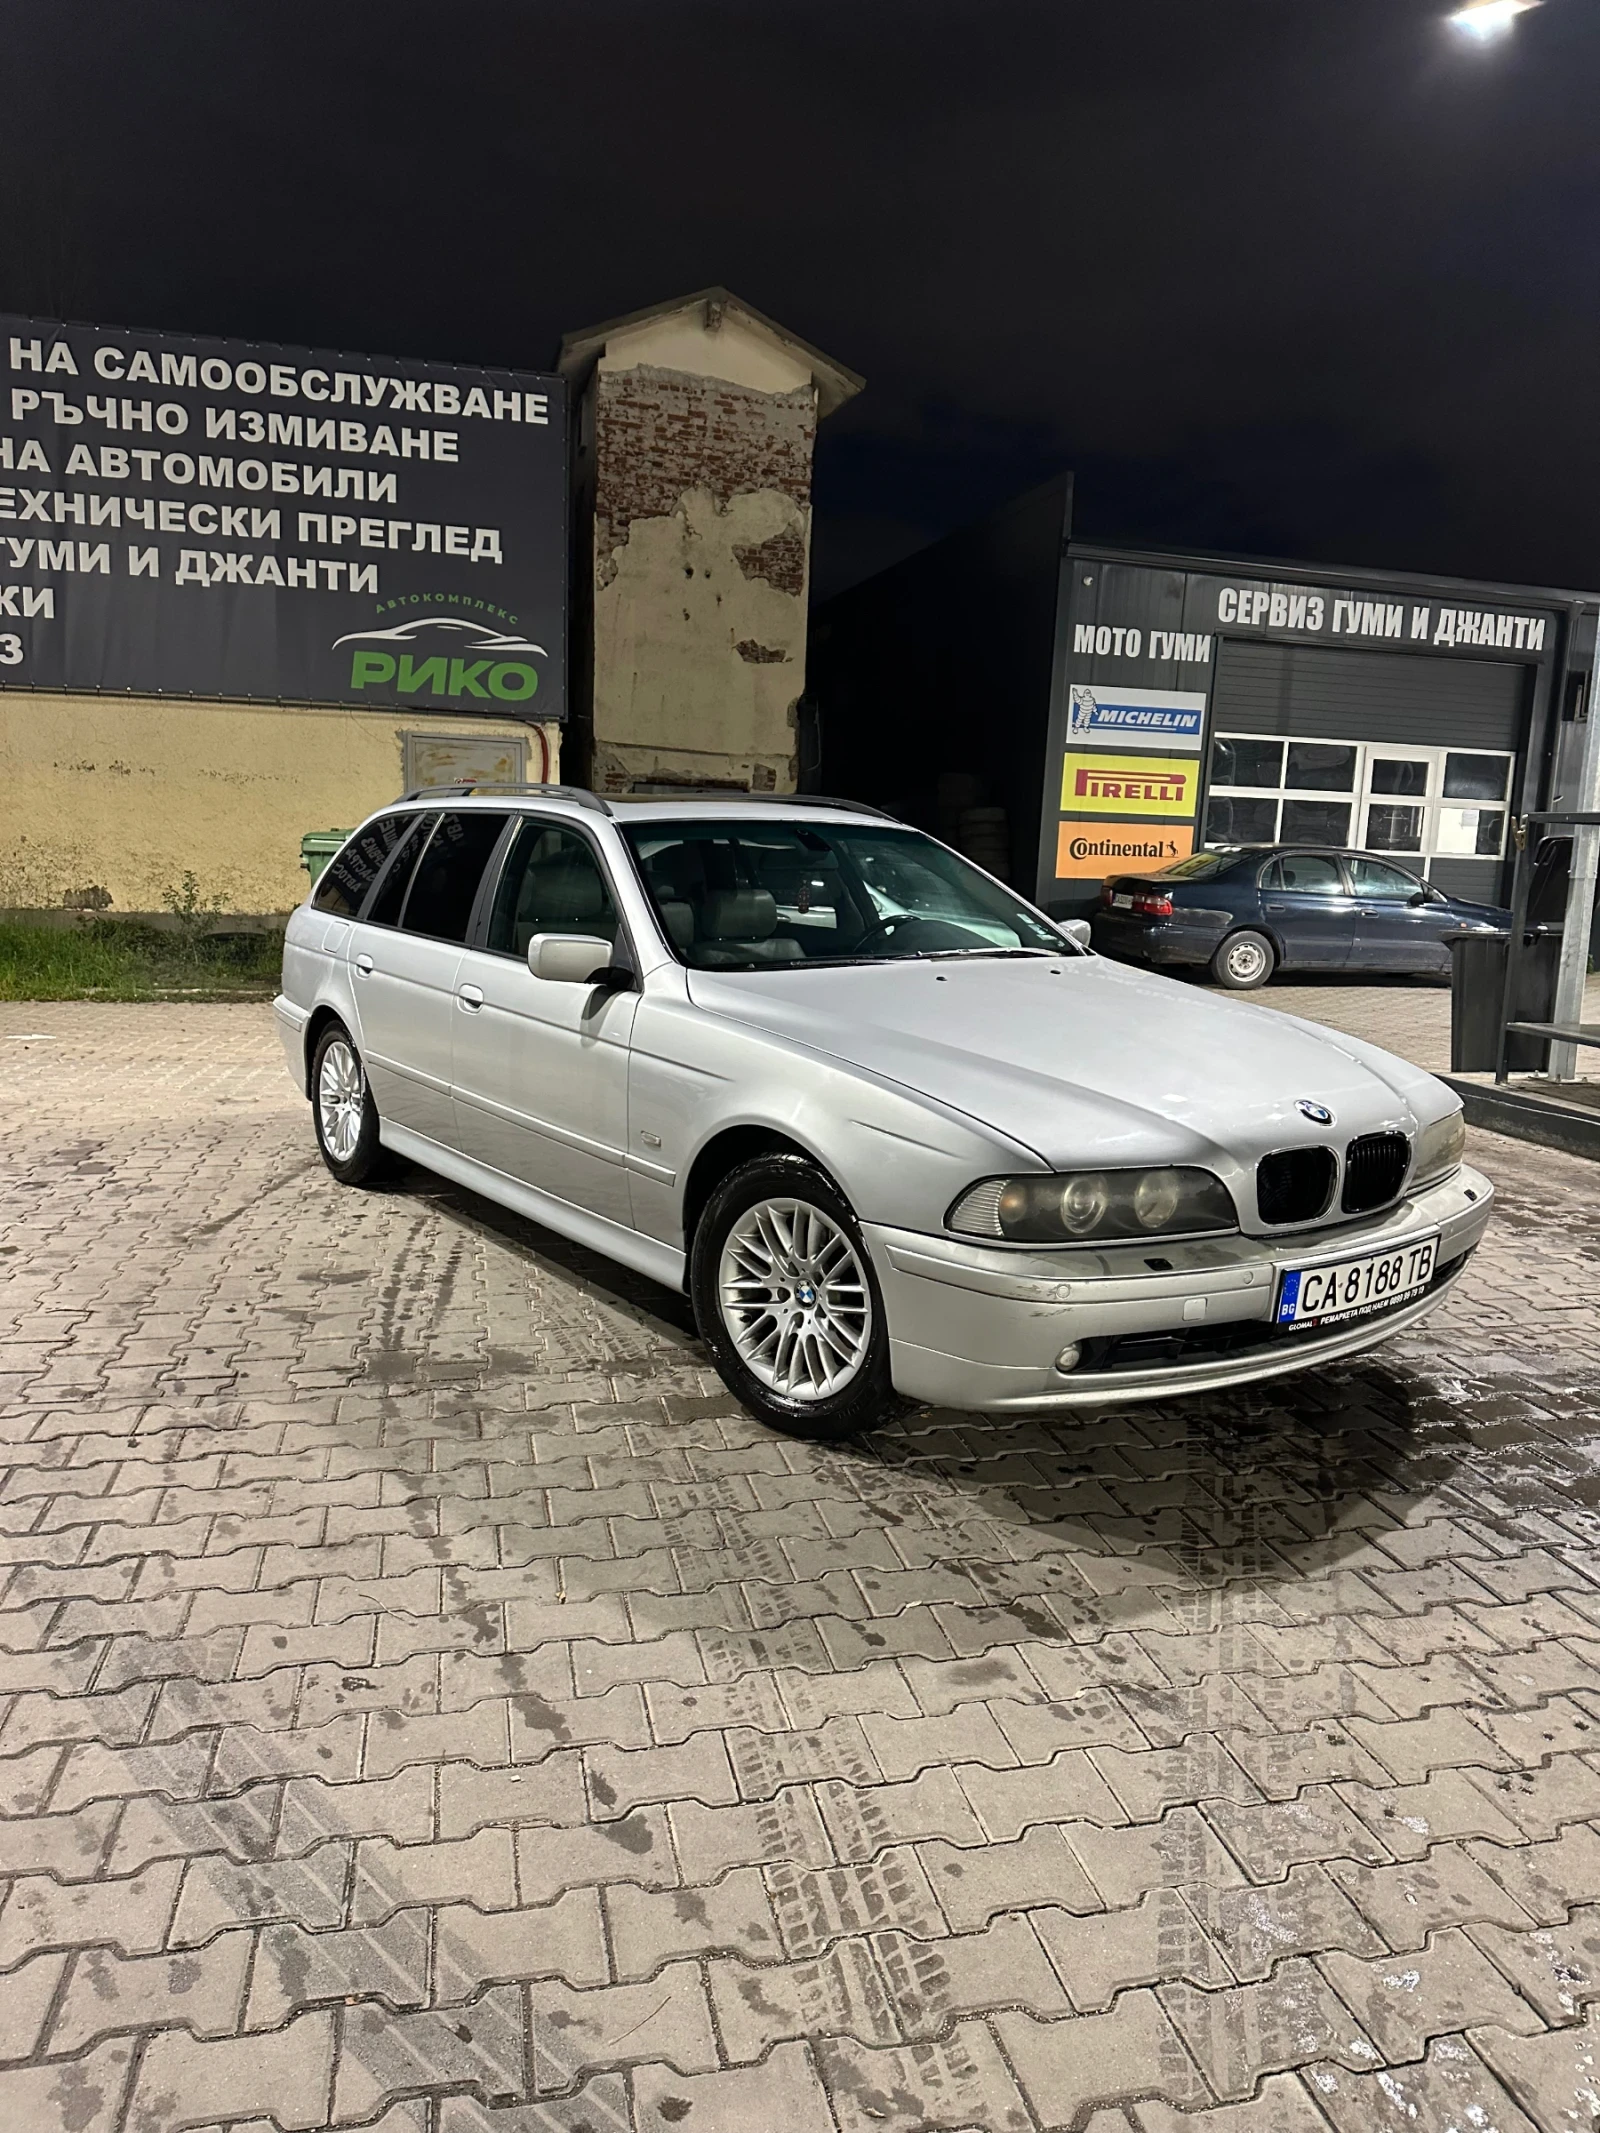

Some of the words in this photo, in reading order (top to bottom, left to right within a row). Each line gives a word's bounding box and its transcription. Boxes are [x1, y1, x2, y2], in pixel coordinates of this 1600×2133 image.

[10, 338, 78, 375] НА
[95, 348, 548, 424] САМООБСЛУЖВАНЕ
[12, 389, 188, 434] РЪЧНО
[206, 408, 458, 462] ИЗМИВАНЕ
[65, 444, 396, 503] АВТОМОБИЛИ
[299, 513, 502, 564] ПРЕГЛЕД
[0, 537, 110, 574] УМИ
[129, 546, 159, 577] И
[175, 550, 377, 593] ДЖАНТИ
[376, 593, 518, 624] АВТОКОМПЛЕКС
[1218, 588, 1324, 630] СЕРВИЗ
[1332, 600, 1403, 637] ГУМИ
[1411, 607, 1429, 639] И
[1433, 609, 1545, 650] ДЖАНТИ
[1074, 624, 1141, 657] МОТО
[1149, 631, 1211, 662] ГУМИ
[351, 650, 538, 701] РИКО
[1098, 709, 1197, 728] MICHELIN
[1074, 768, 1187, 801] PIRELLI
[1069, 837, 1164, 860] Continental
[1281, 1303, 1295, 1316] BG
